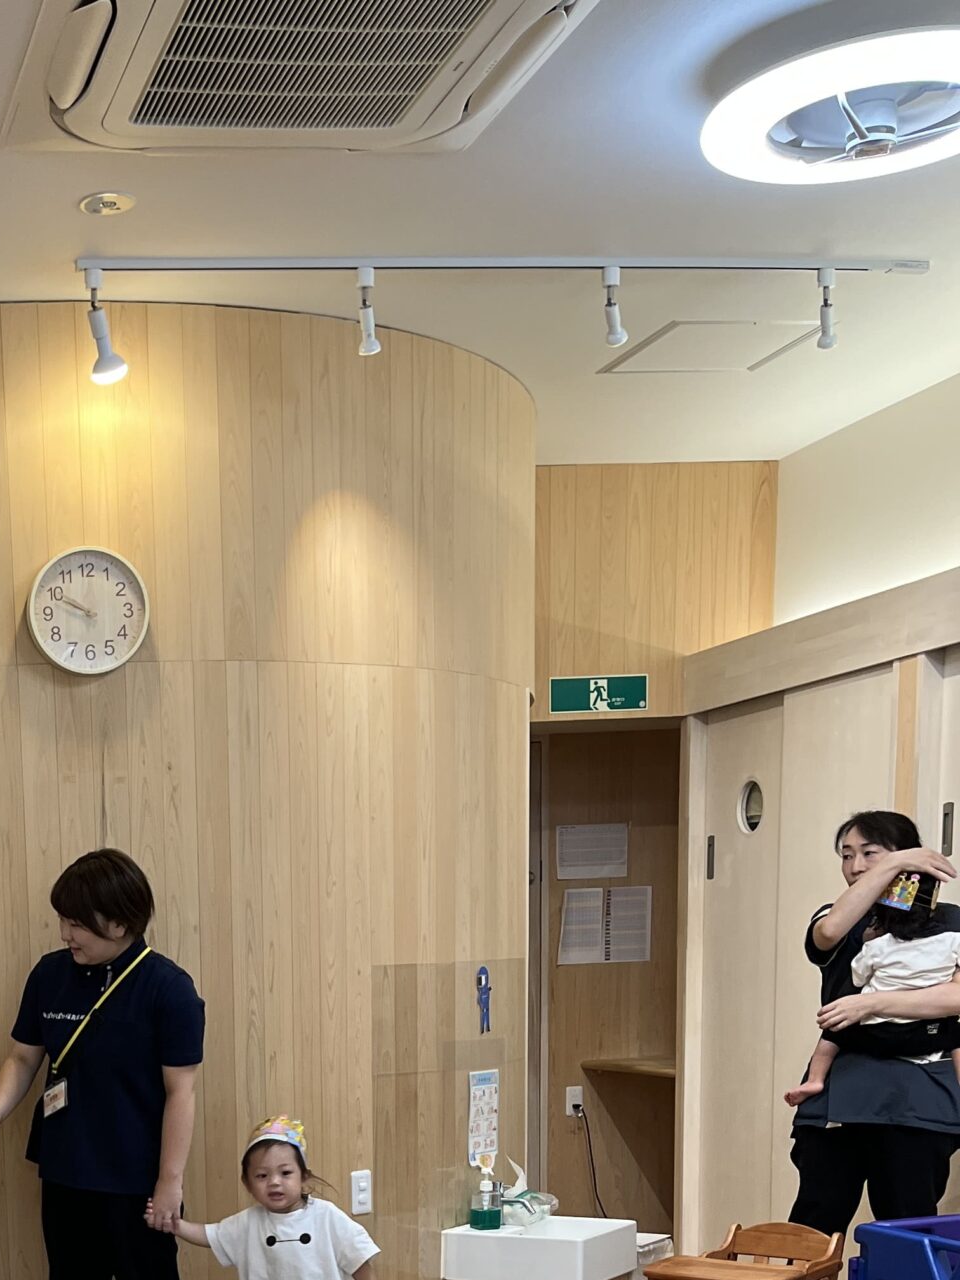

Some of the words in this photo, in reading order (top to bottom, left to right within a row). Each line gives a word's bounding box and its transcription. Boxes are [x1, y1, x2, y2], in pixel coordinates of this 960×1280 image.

[59, 570, 72, 584] 11
[78, 563, 95, 577] 12
[103, 567, 109, 581] 1
[47, 586, 63, 601] 10
[115, 582, 126, 597] 2
[43, 606, 54, 621] 9
[123, 602, 134, 618] 3
[51, 626, 62, 642] 8
[117, 624, 128, 640] 4
[67, 642, 78, 658] 7
[85, 644, 96, 660] 6
[104, 640, 115, 656] 5
